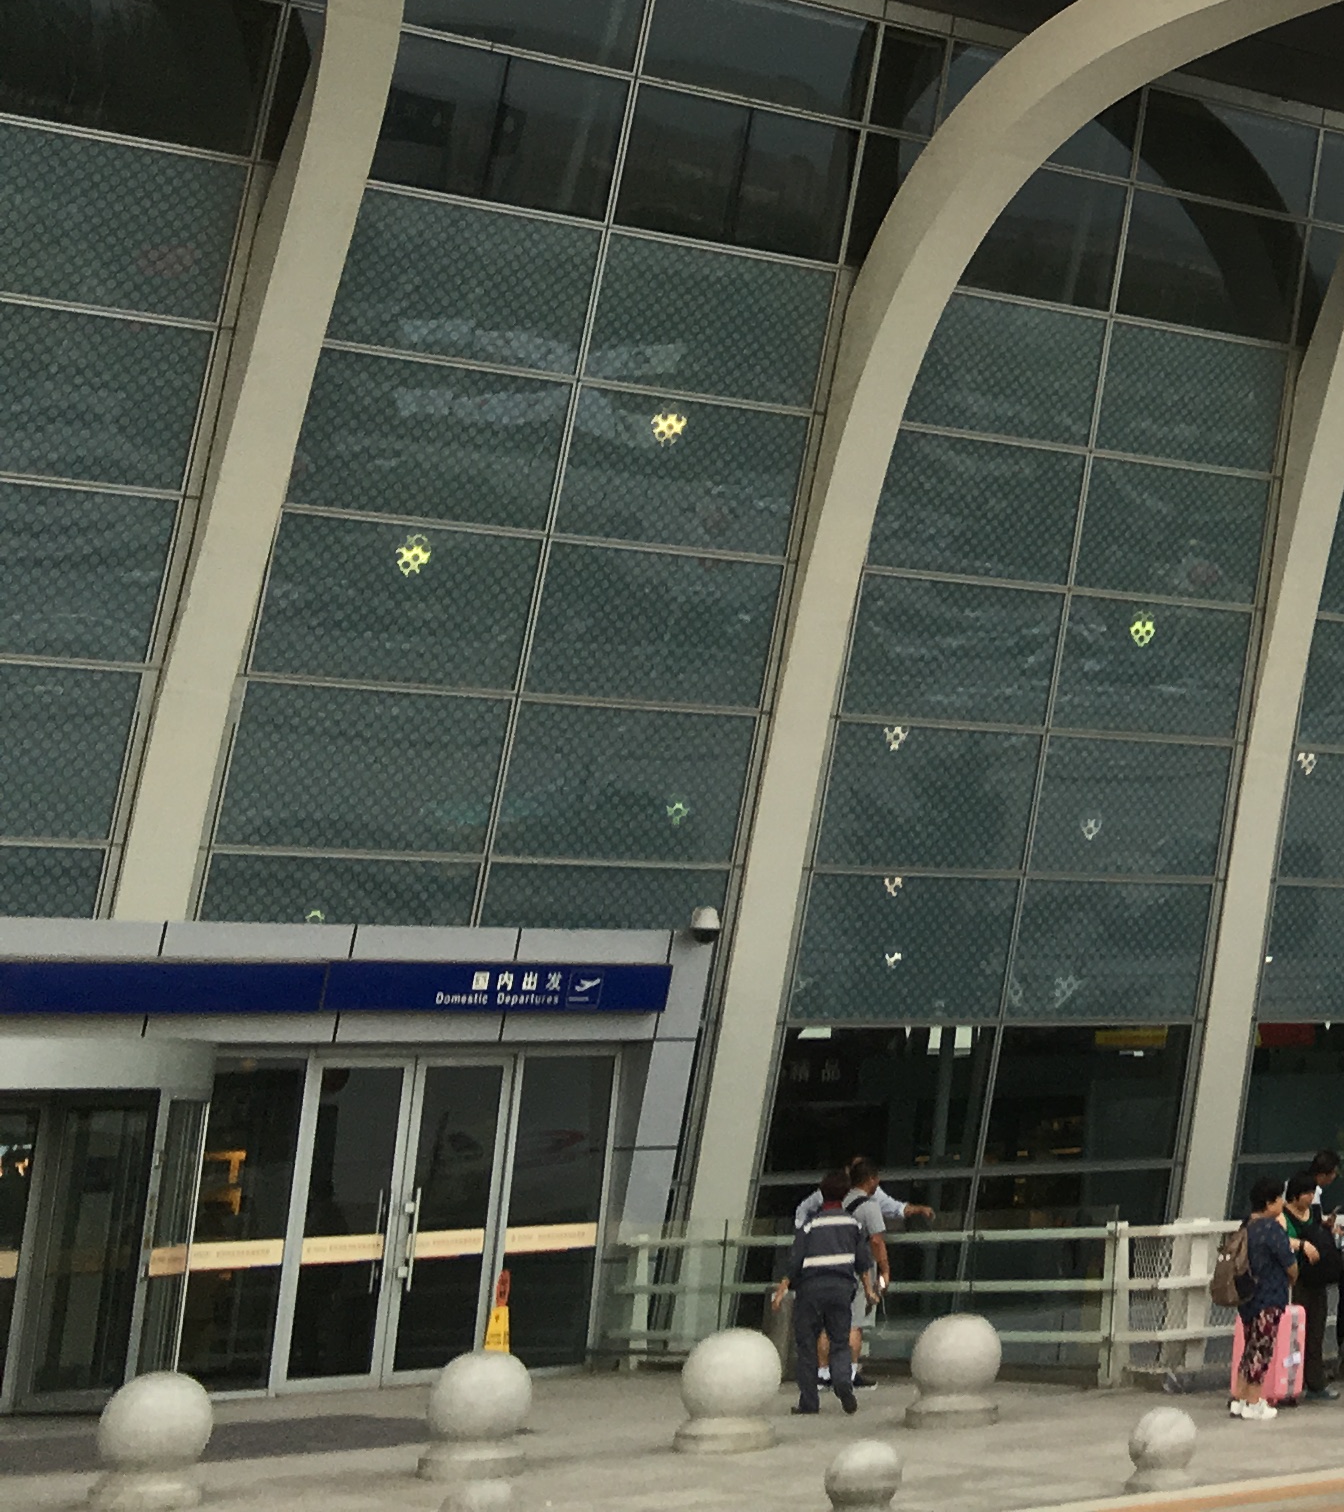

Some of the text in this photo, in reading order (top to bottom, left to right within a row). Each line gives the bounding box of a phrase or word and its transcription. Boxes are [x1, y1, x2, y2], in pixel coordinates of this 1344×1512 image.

[472, 970, 563, 992] 国内出发
[435, 991, 560, 1007] Domestic Departures
